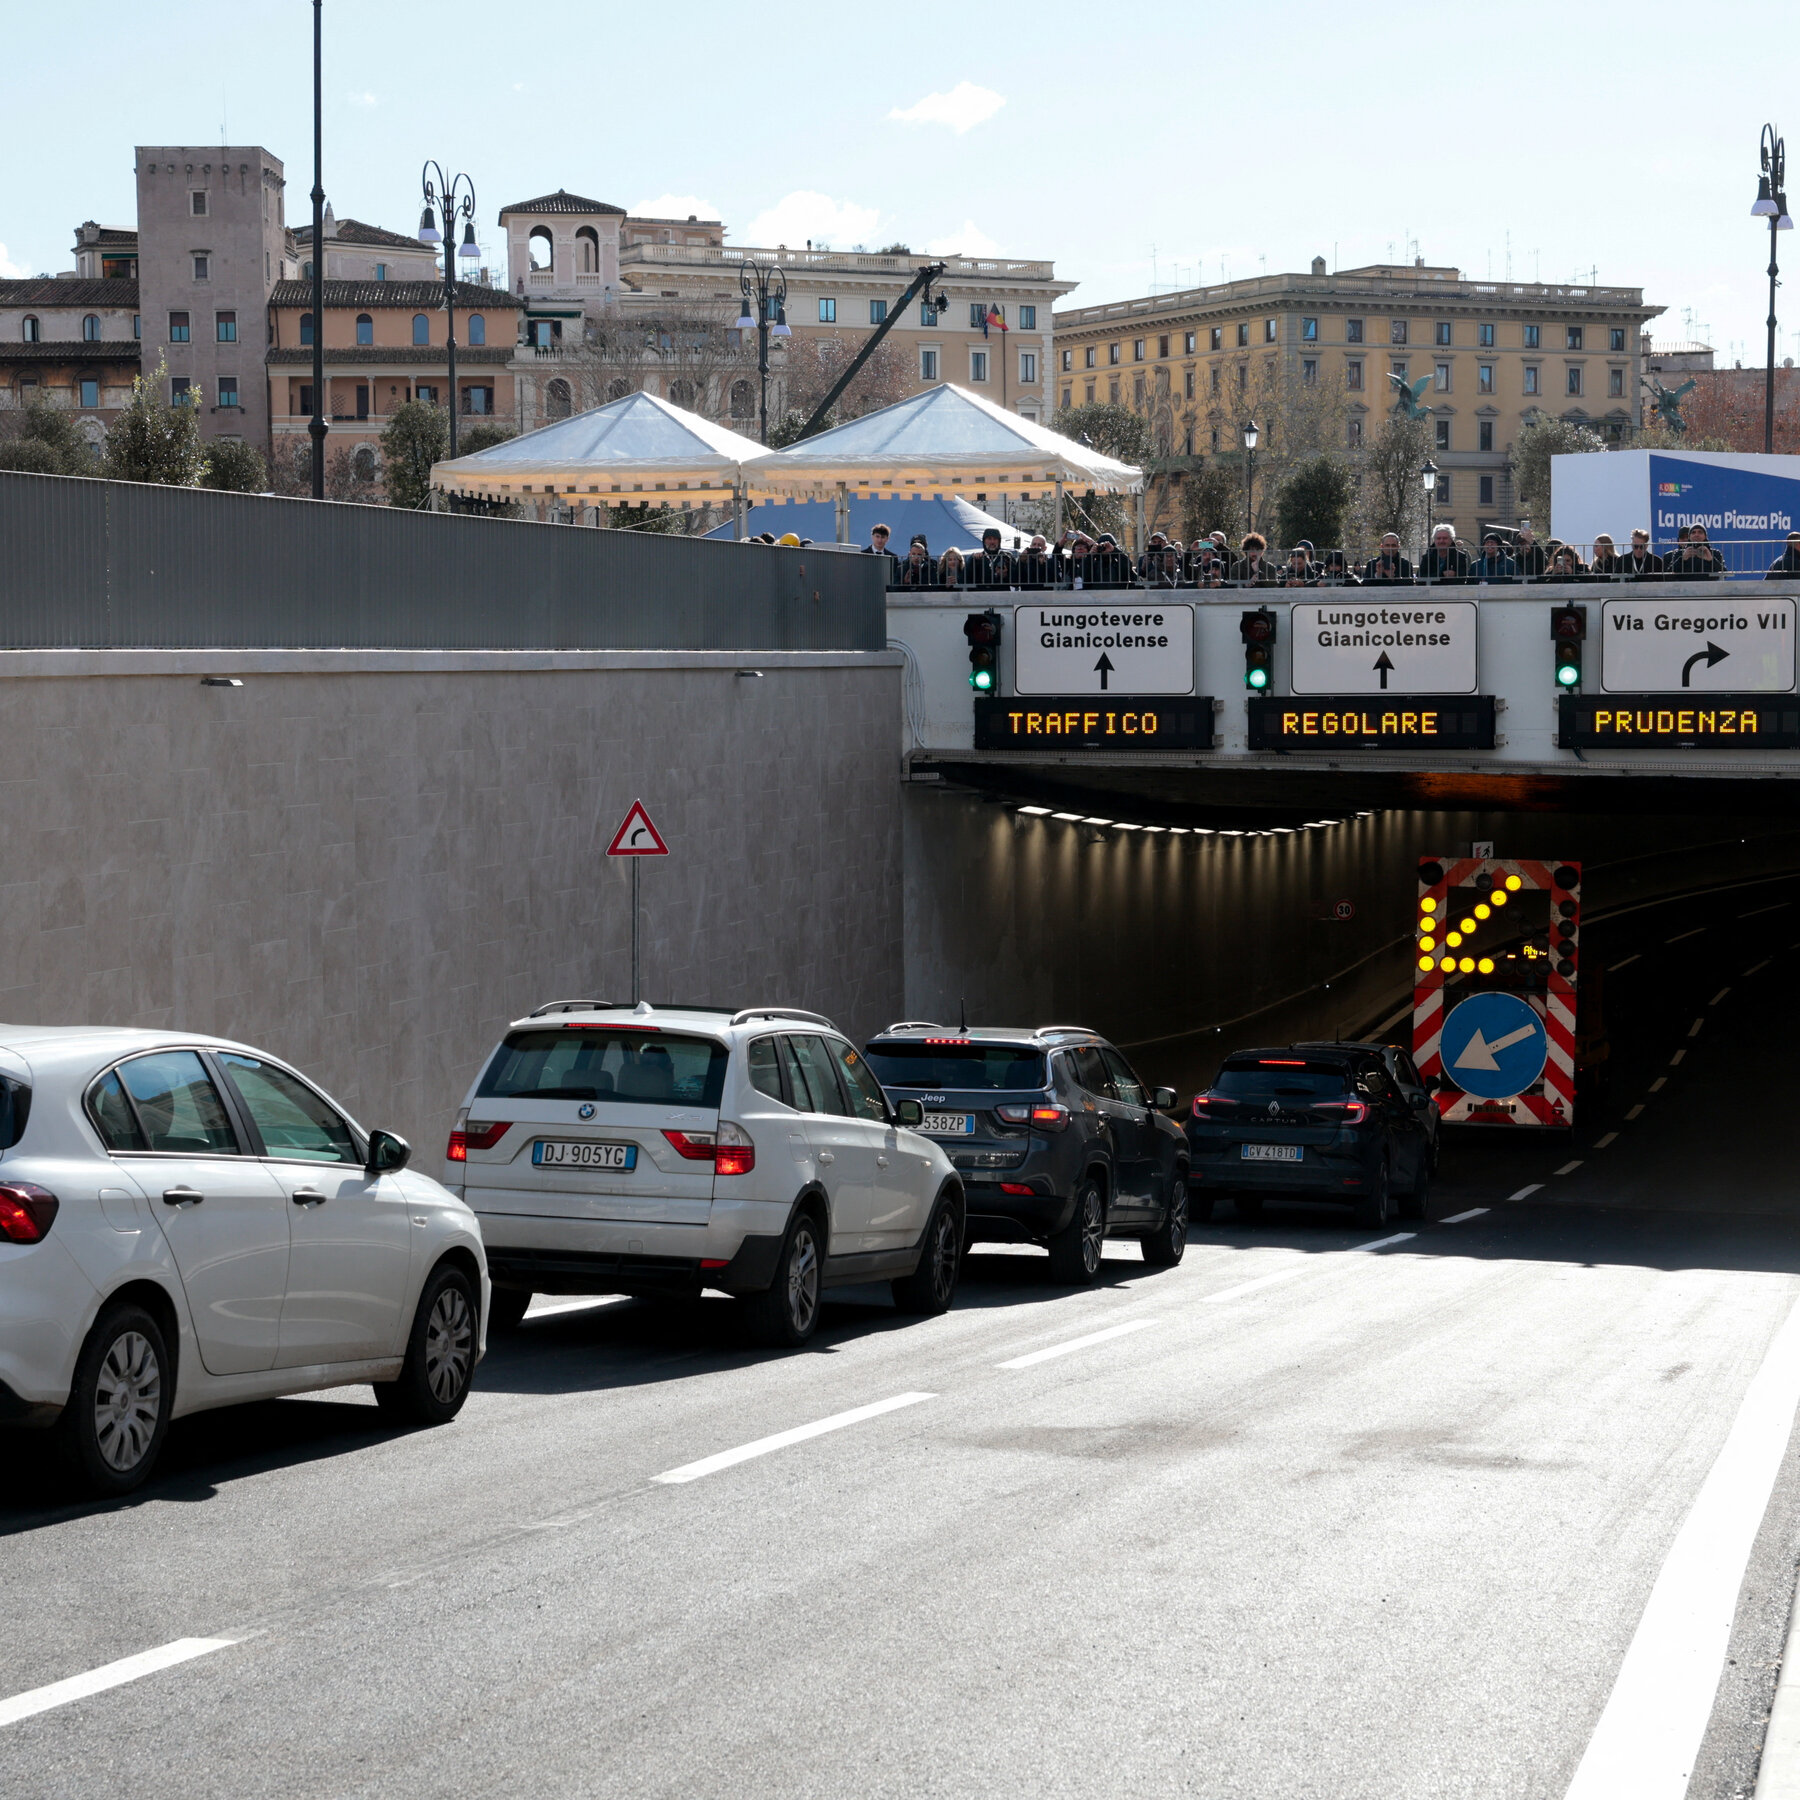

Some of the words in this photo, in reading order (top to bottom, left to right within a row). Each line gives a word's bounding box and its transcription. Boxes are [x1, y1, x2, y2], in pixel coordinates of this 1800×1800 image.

[1658, 509, 1674, 527] La
[1677, 513, 1721, 529] nuova
[1724, 509, 1768, 530] Piazza
[1770, 511, 1791, 530] Pia
[1040, 611, 1164, 629] Lungotevere
[1318, 609, 1446, 628] Lungotevere
[1612, 614, 1644, 631] Via
[1654, 613, 1748, 633] Gregorio
[1757, 613, 1786, 630] VII
[1040, 632, 1168, 648] Gianicolense
[1318, 630, 1451, 647] Gianicolense
[1008, 712, 1157, 734] TRAFFICO
[1283, 712, 1438, 734] REGOLARE
[1595, 711, 1757, 733] PRUDENZA
[1338, 905, 1350, 915] 30
[920, 1093, 946, 1104] Jeep
